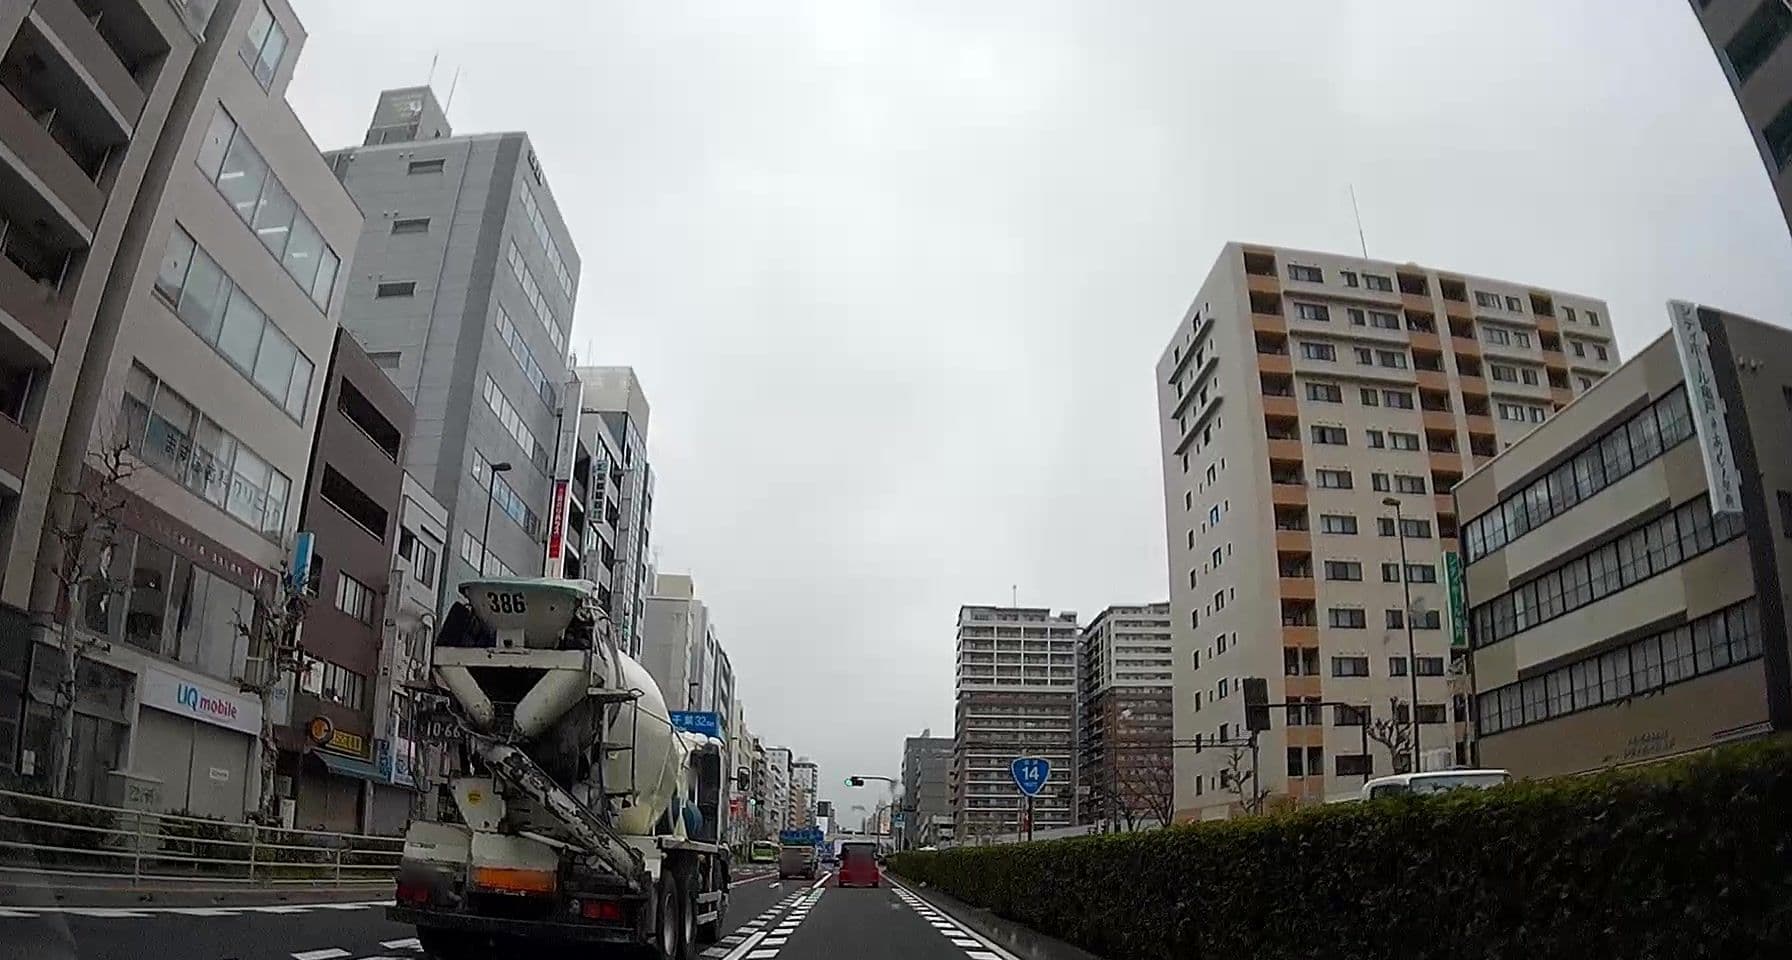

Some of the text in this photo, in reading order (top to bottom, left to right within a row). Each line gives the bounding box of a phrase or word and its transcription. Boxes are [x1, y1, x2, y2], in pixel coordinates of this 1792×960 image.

[487, 591, 526, 614] 386
[177, 683, 238, 719] UQ mobile
[1021, 766, 1040, 780] 14
